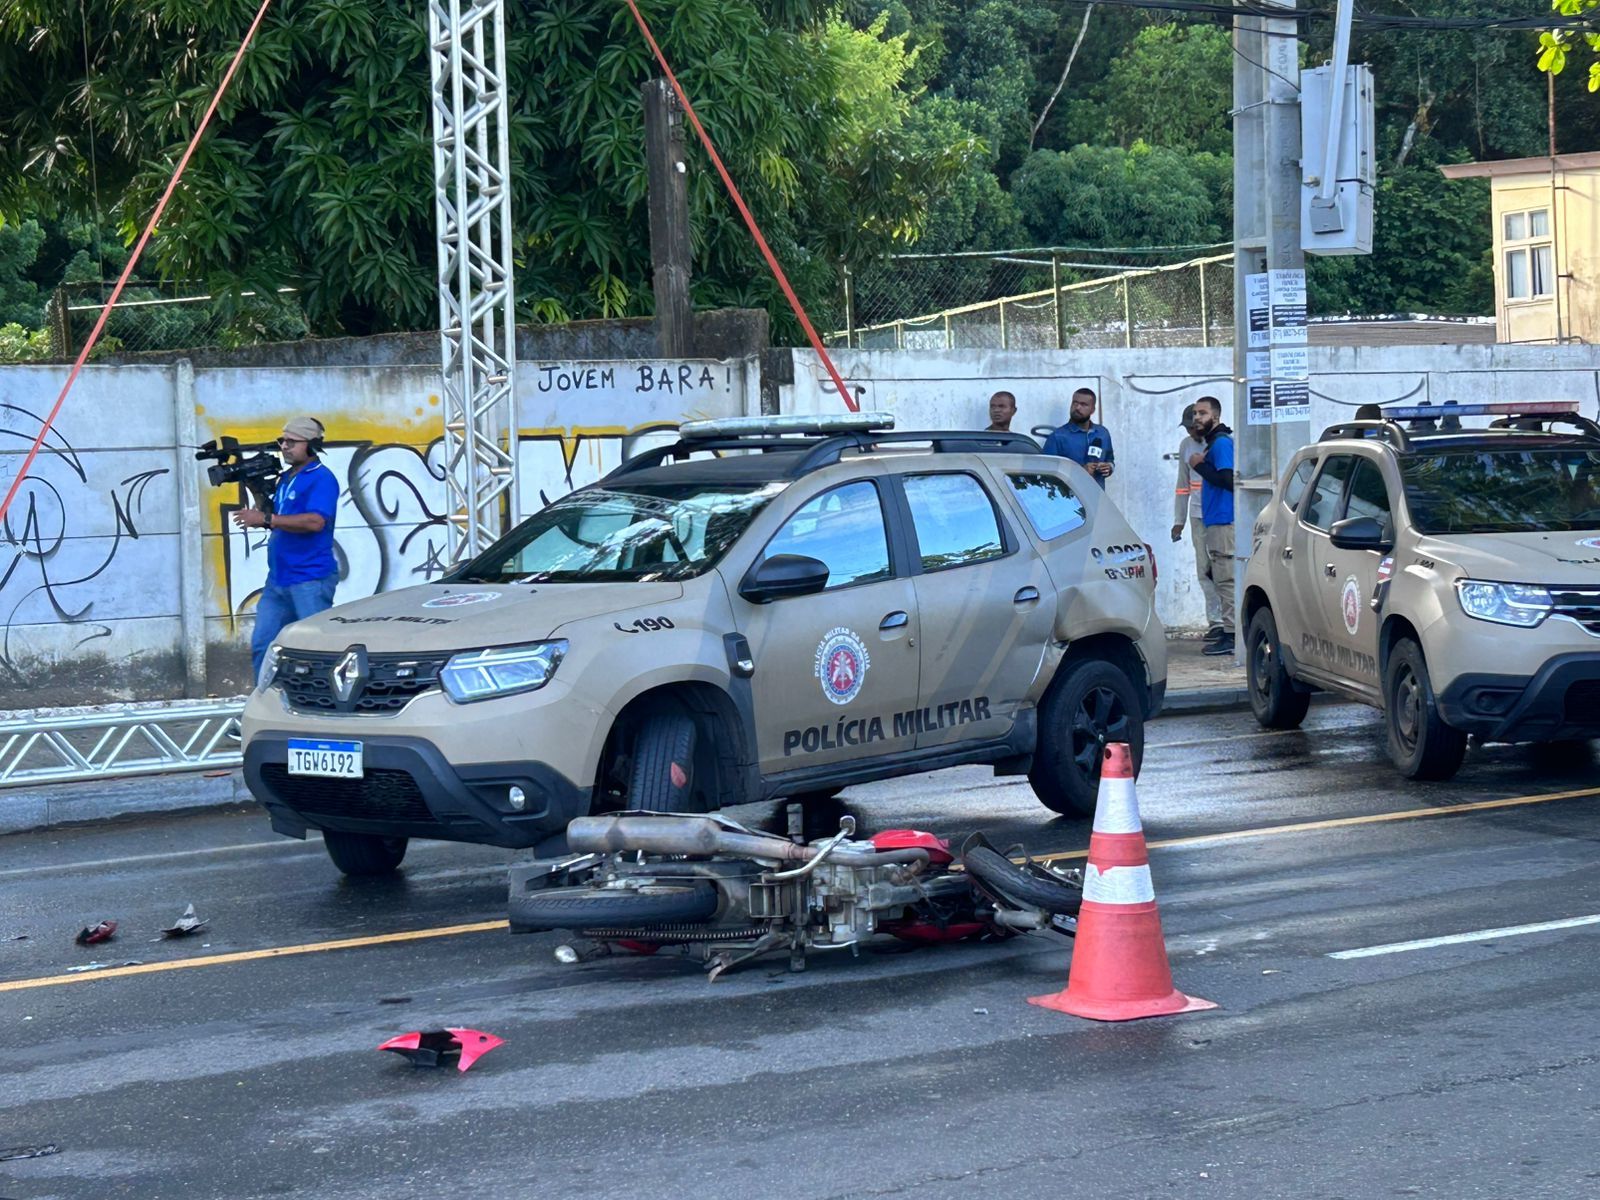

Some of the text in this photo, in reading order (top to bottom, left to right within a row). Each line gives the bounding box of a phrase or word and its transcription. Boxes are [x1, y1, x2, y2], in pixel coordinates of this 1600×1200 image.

[538, 366, 615, 392] JOVEM
[633, 616, 675, 631] 190
[783, 696, 992, 757] POLÍCIA MILITAR
